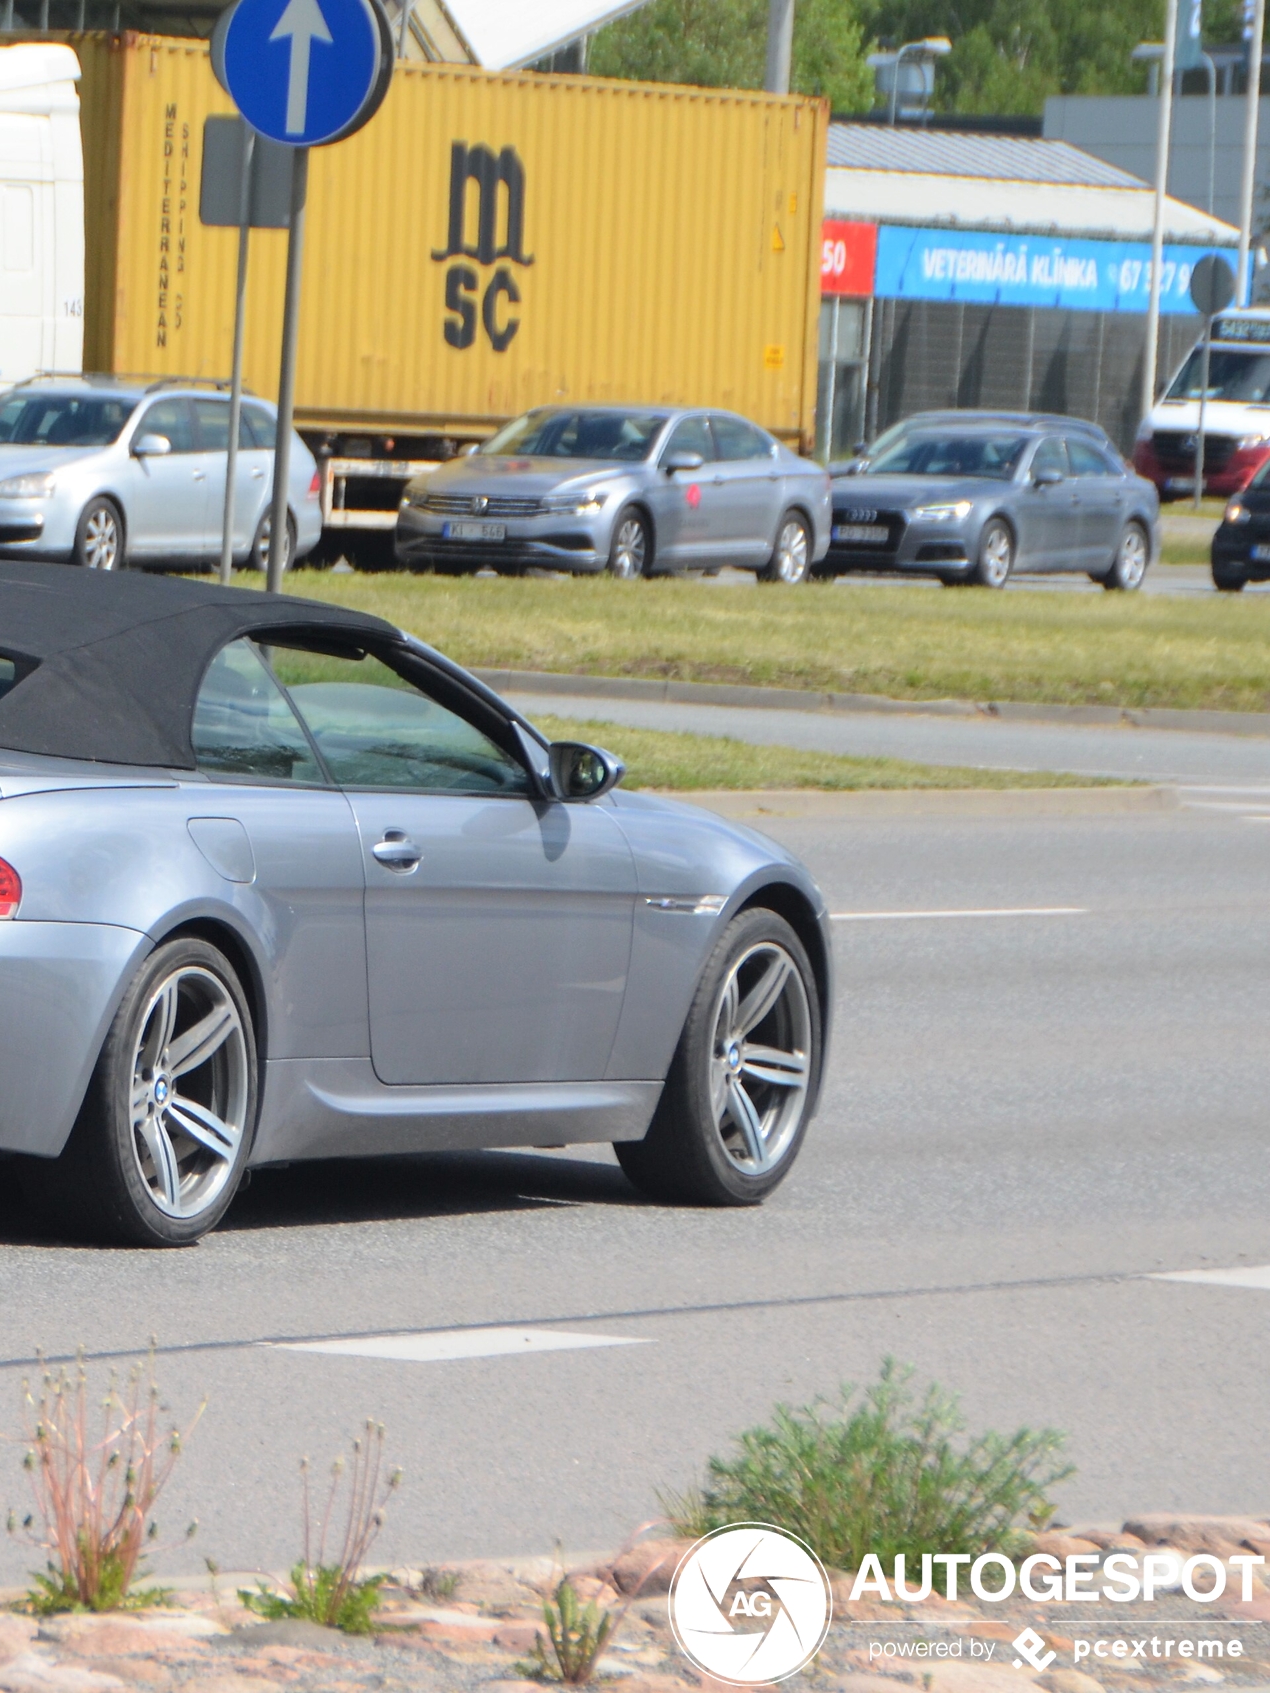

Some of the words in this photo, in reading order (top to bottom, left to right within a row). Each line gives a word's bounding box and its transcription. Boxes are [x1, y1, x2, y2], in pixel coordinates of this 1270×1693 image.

[157, 103, 177, 347] MEDITERRANEAN
[923, 243, 1028, 283] VETERINĀRĀ
[1032, 248, 1098, 290] KLĪNIKA
[1119, 260, 1142, 292] 67
[64, 301, 83, 317] 143
